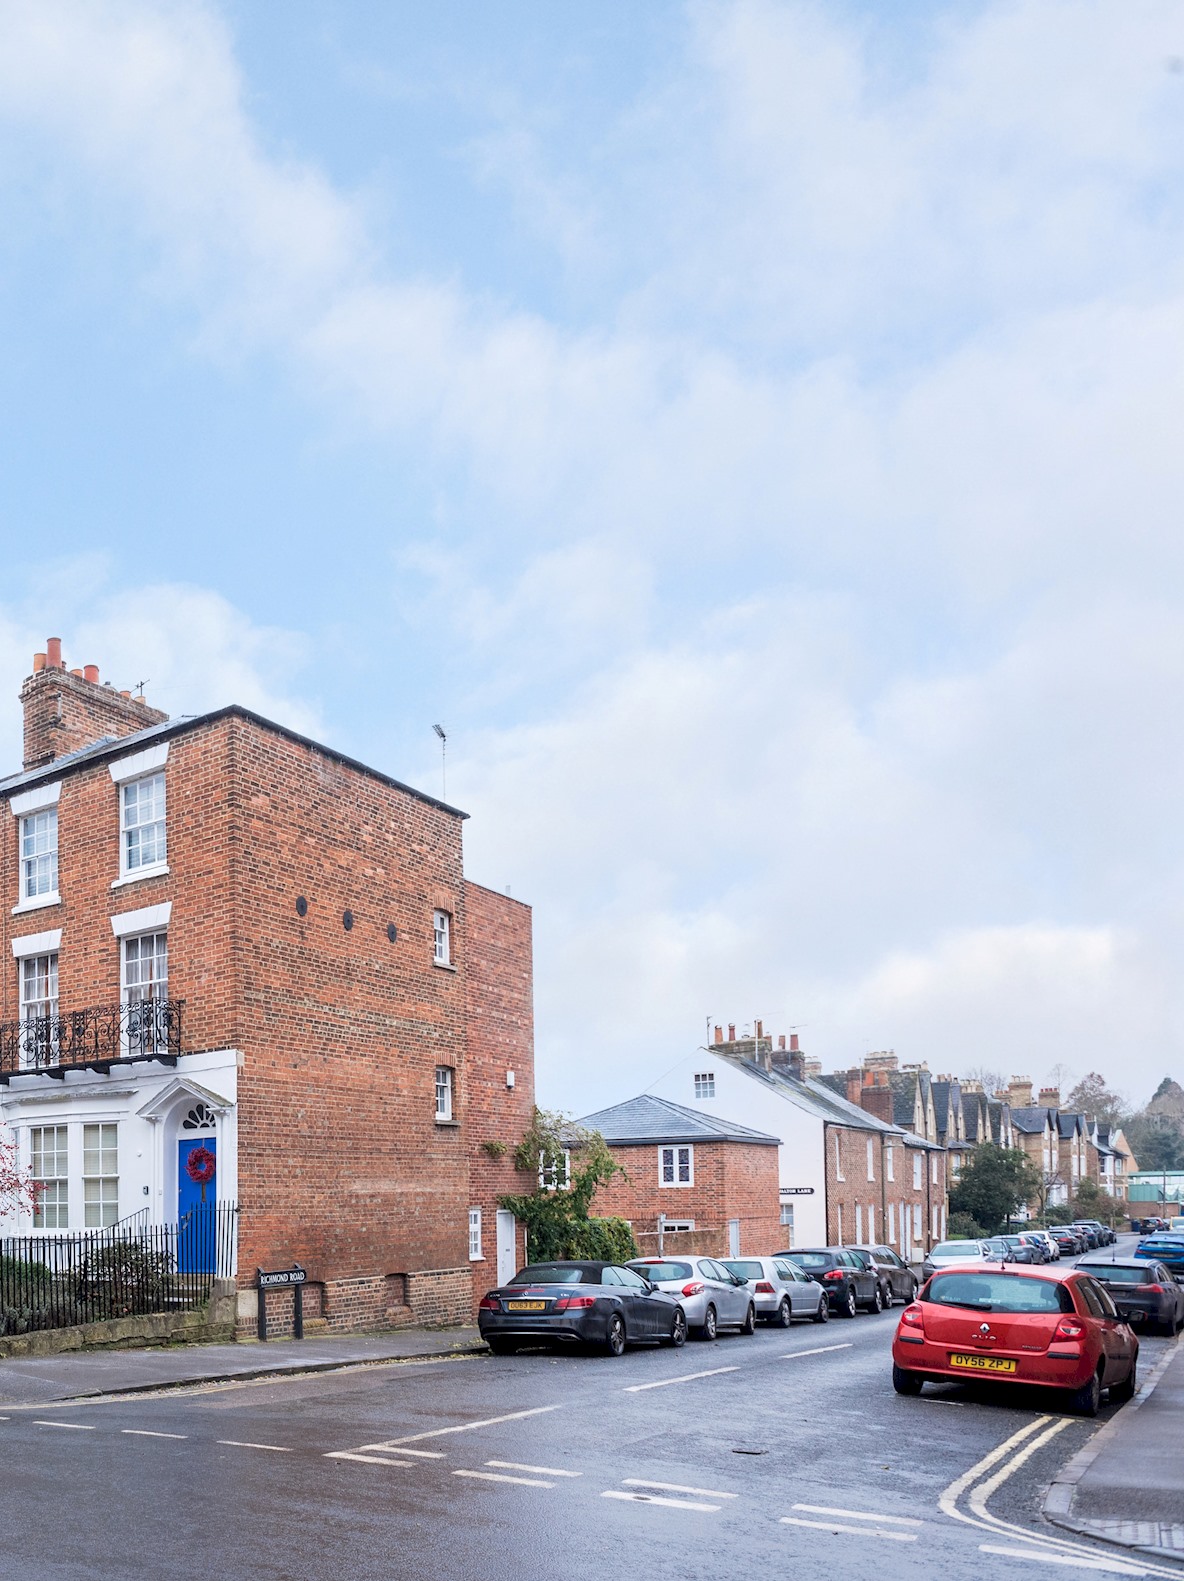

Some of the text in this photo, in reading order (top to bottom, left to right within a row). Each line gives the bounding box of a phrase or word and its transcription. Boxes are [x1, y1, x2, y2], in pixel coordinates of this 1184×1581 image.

[261, 1272, 305, 1285] RICHMOND ROAD
[956, 1355, 1012, 1370] OY56 ZPJ
